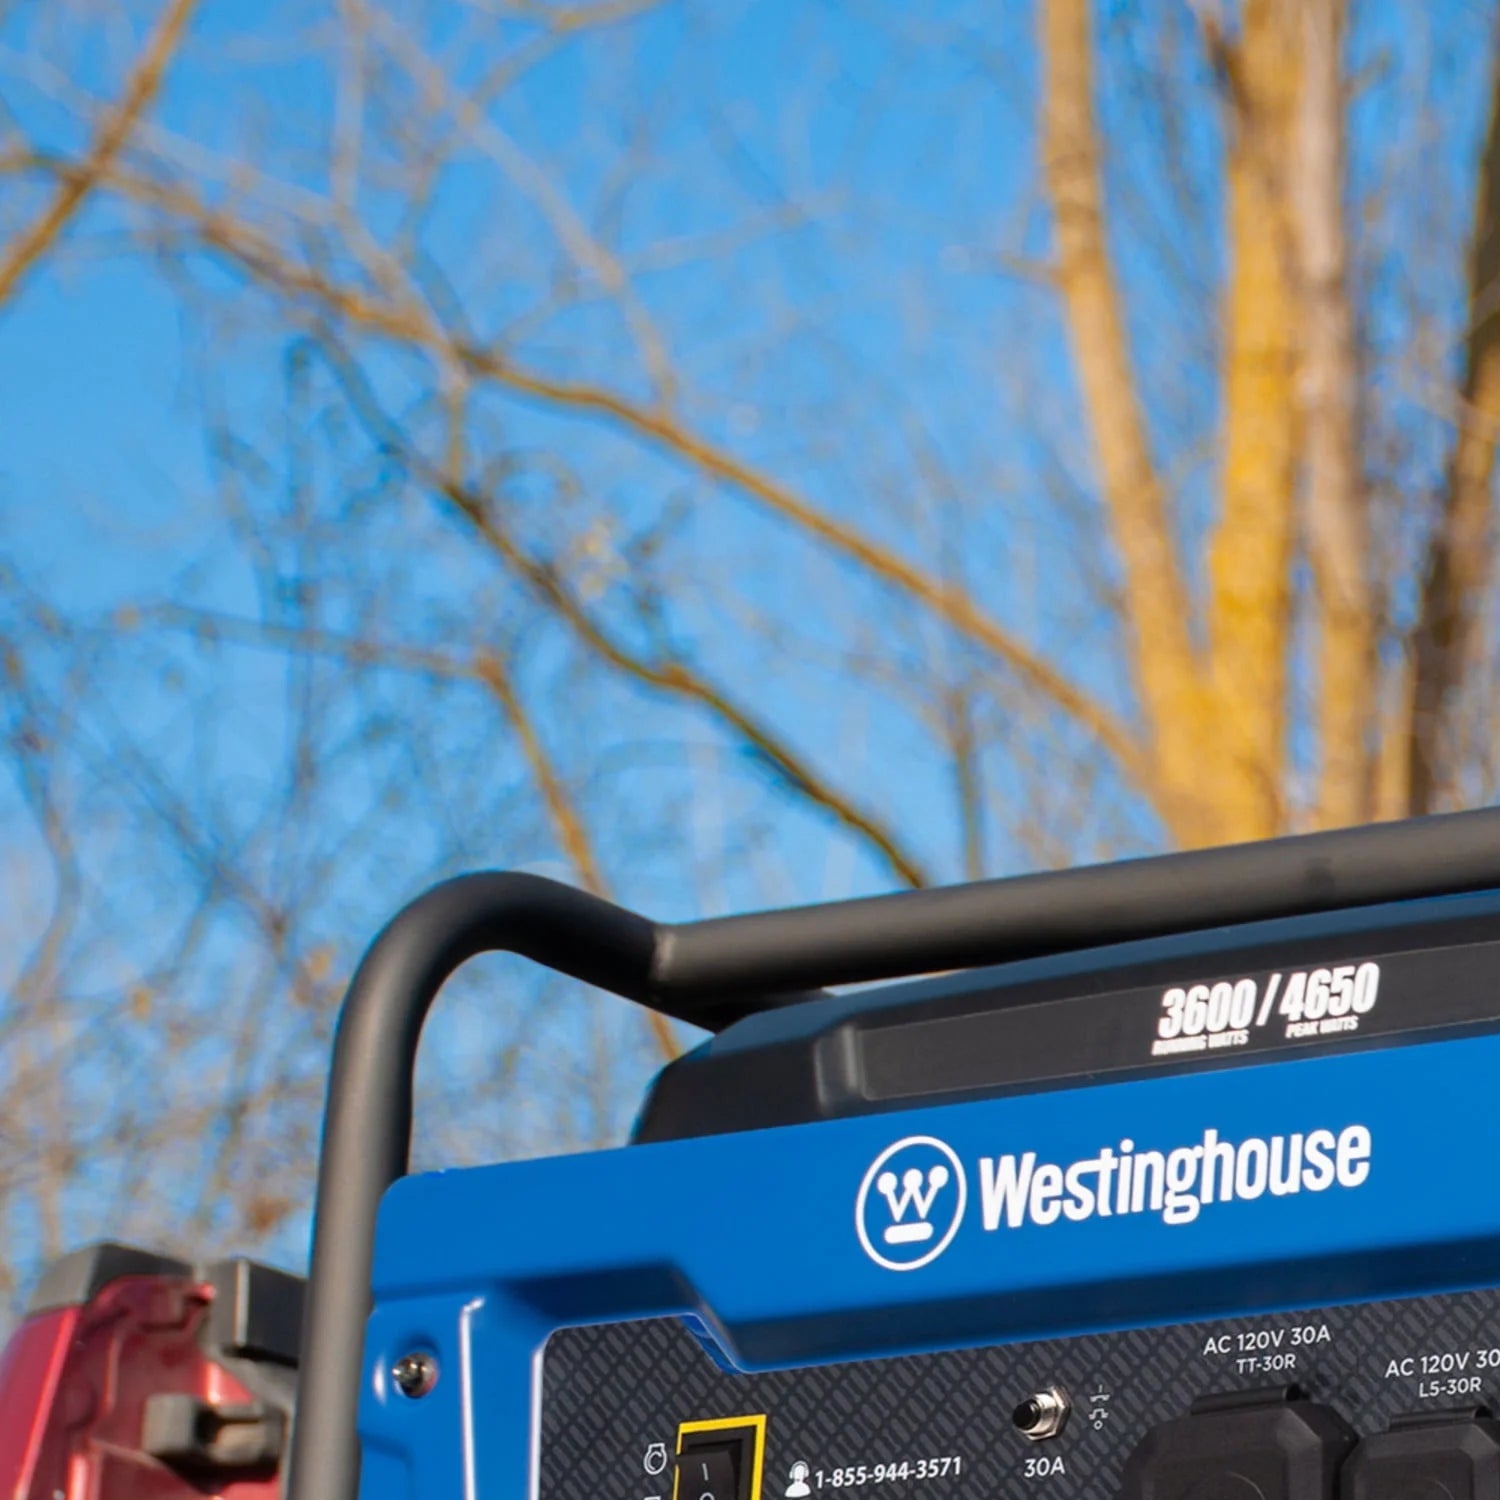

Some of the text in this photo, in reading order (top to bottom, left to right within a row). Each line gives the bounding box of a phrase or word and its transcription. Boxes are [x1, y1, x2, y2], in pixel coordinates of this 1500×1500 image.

[1285, 1015, 1359, 1038] PEAK WATTS
[979, 1124, 1372, 1230] Westinghouse
[1203, 1325, 1331, 1356] AC 120V 30A
[1236, 1353, 1297, 1375] TT-30R
[1385, 1357, 1413, 1378] AC
[1418, 1352, 1470, 1374] 120V
[1418, 1376, 1482, 1399] L5-30R
[814, 1456, 963, 1490] 1-855-944-3571
[1024, 1457, 1066, 1478] 30A
